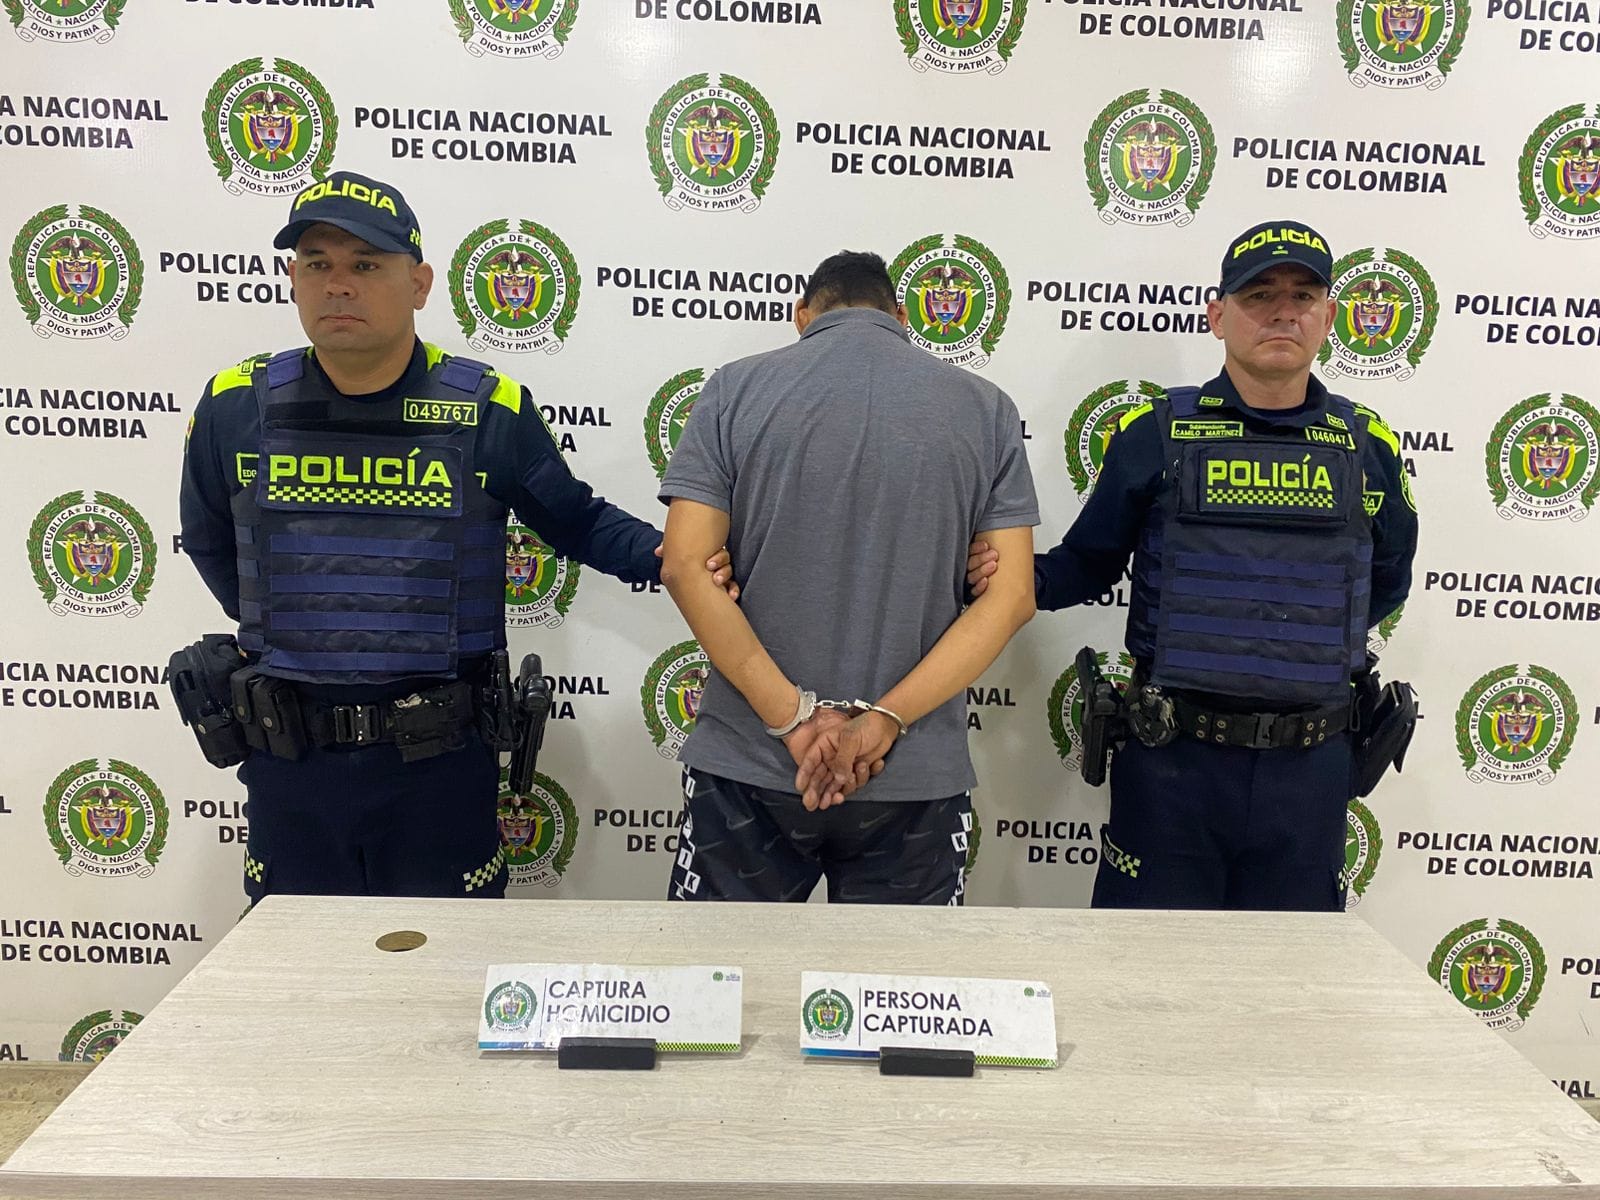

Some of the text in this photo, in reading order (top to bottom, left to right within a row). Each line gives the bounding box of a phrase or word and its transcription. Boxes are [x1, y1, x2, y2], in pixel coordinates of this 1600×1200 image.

[637, 0, 821, 24] DE COLOMBIA
[1488, 0, 1589, 23] POLICIA
[1080, 13, 1263, 40] DE COLOMBIA
[1520, 29, 1552, 50] DE
[24, 96, 168, 120] NACIONAL
[263, 73, 279, 83] DE
[288, 79, 321, 137] COLOMBIA
[355, 108, 612, 136] POLICIA NACIONAL
[708, 89, 724, 98] DE
[732, 95, 763, 152] COLOMBIA
[0, 125, 133, 149] OLOMBIA
[797, 122, 1050, 151] POLICIA NACIONAL
[1148, 104, 1164, 114] DE
[1171, 110, 1199, 167] COLOMBIA
[392, 138, 576, 163] DE COLOMBIA
[1234, 138, 1485, 165] POLICIA NACIONAL
[272, 145, 317, 181] NACIONAL
[832, 153, 1013, 178] DE COLOMBIA
[273, 179, 307, 194] PATRIA
[712, 161, 758, 196] NACIONAL
[1267, 168, 1447, 193] DE COLOMBIA
[712, 194, 746, 209] PATRIA
[1147, 175, 1194, 210] NACIONAL
[1146, 208, 1180, 223] PATRIA
[69, 220, 84, 229] DE
[93, 226, 127, 282] COLOMBIA
[160, 252, 265, 275] POLICIA
[509, 234, 524, 243] DE
[532, 240, 564, 296] COLOMBIA
[598, 267, 701, 290] POLICIA
[198, 281, 228, 302] DE
[1028, 281, 1130, 303] POLICIA
[80, 290, 124, 324] NACIONAL
[633, 297, 793, 322] DE COLOMBI
[1455, 294, 1556, 317] POLICIA
[81, 322, 115, 336] PATRIA
[515, 304, 560, 338] NACIONAL
[1061, 309, 1212, 334] DE COLOMB
[515, 336, 549, 350] PATRIA
[1487, 323, 1600, 346] DE COLO
[41, 390, 180, 412] NACIONAL
[409, 403, 473, 422] 049767
[6, 416, 147, 438] COLOMBIA
[1175, 429, 1201, 437] CAMILO
[1312, 428, 1347, 445] 046047
[269, 447, 452, 488] POLICÍA
[1207, 453, 1333, 491] POLICÍA
[84, 505, 100, 514] DE
[108, 510, 141, 563] COLOMBIA
[95, 570, 138, 602] NACIONAL
[1425, 572, 1523, 593] POLICIA
[96, 600, 128, 614] PATRIA
[1456, 598, 1600, 621] DE COLOMB
[57, 664, 167, 684] NACIONA
[23, 689, 159, 710] COLOMBIA
[995, 819, 1093, 840] POLICIA
[627, 834, 656, 853] DE
[1028, 845, 1058, 864] DE
[1398, 832, 1600, 856] POLICIA NACION
[1428, 856, 1593, 879] DE COLOMBIA
[0, 919, 202, 941] LICIA NACIONAL
[1, 943, 170, 965] DE COLOMBIA
[549, 980, 647, 999] CAPTURA
[864, 990, 961, 1011] PERSONA
[546, 1004, 670, 1024] HOMICIDIO
[864, 1014, 993, 1037] CAPTURADA
